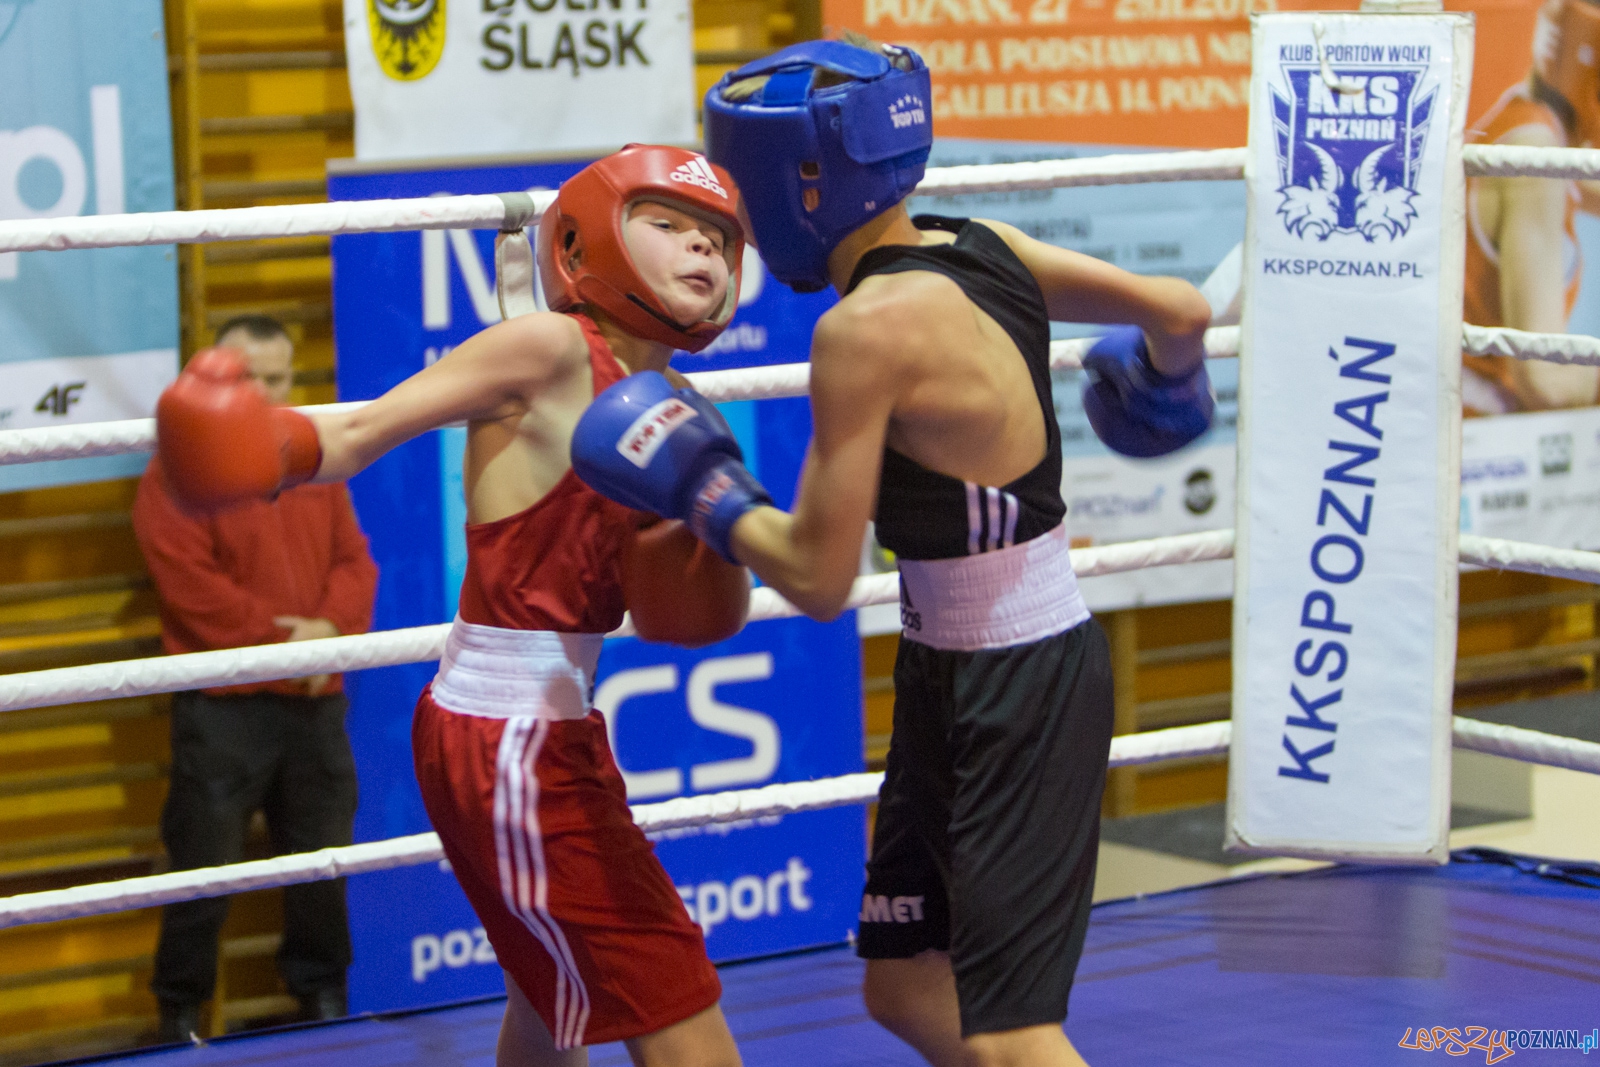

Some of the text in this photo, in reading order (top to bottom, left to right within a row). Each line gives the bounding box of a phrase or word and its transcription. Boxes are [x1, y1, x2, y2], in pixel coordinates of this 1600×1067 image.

[1280, 45, 1313, 62] KLUB
[1307, 72, 1400, 116] KKS
[1305, 116, 1397, 141] POZNAŃ
[1264, 258, 1423, 279] KKSPOZNAN.PL
[34, 381, 86, 416] 4F
[1278, 336, 1397, 784] KKSPOZNAŃ
[859, 893, 925, 923] MET
